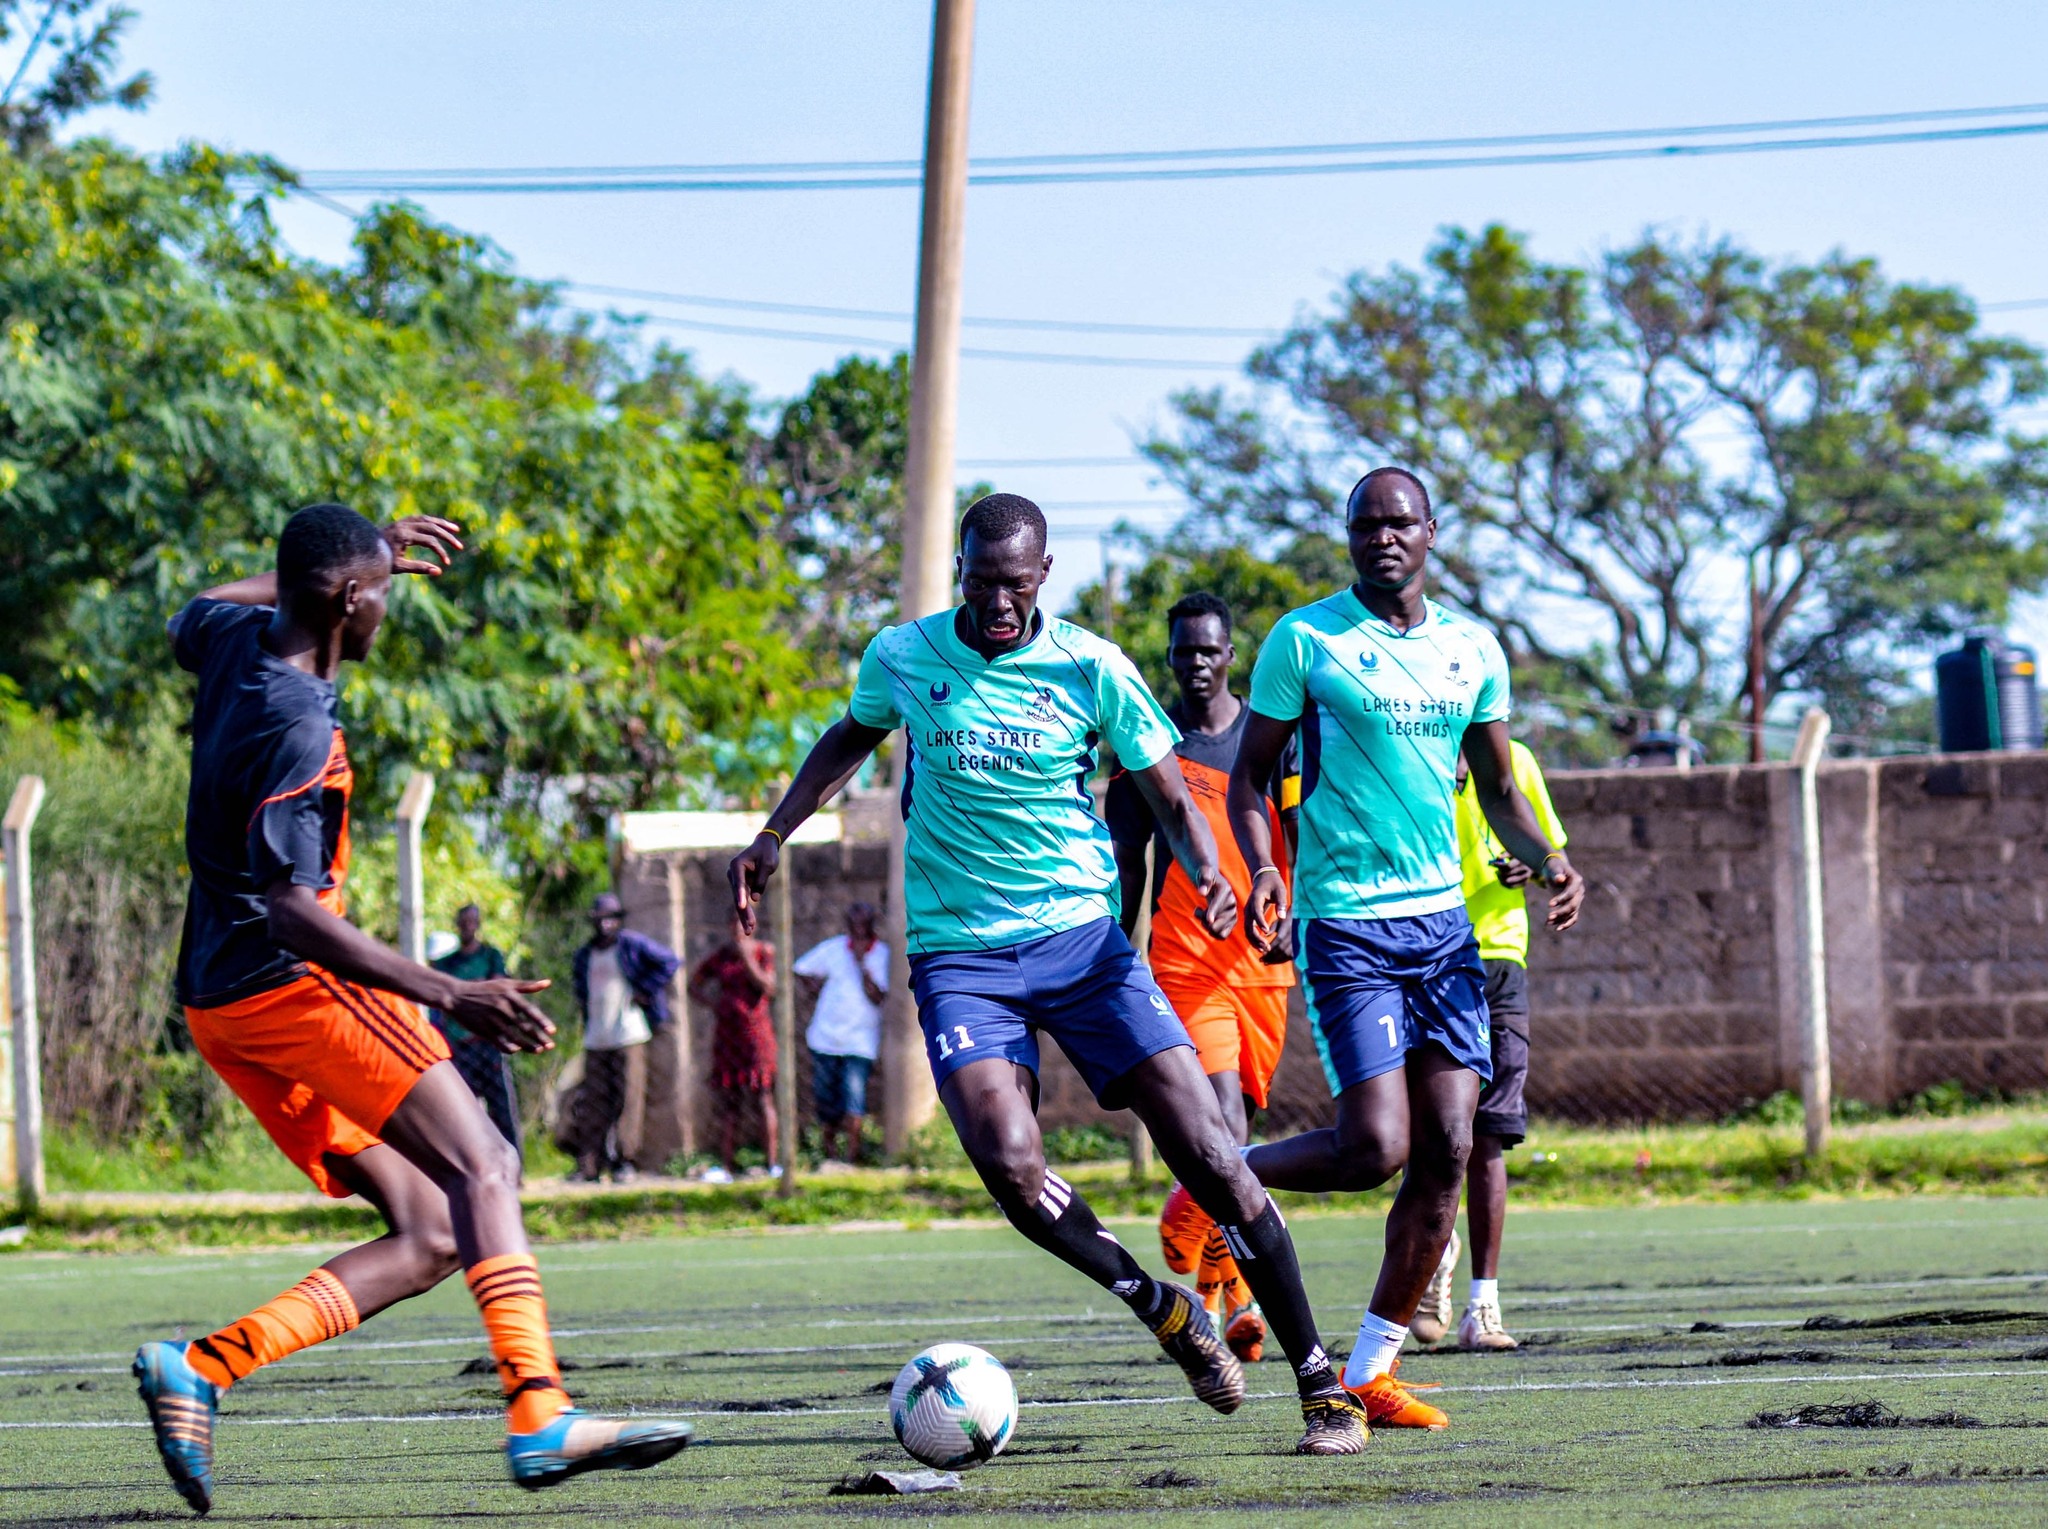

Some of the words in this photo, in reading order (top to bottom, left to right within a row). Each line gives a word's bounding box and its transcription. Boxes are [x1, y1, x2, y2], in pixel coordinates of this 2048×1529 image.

[1363, 698, 1411, 713] LAKES
[1420, 699, 1463, 717] STATE
[1386, 721, 1449, 738] LEGENDS
[927, 730, 977, 747] LAKES
[987, 731, 1041, 748] STATE
[948, 756, 1025, 771] LEGENDS
[935, 1025, 975, 1061] 11
[1300, 1357, 1330, 1377] adida
